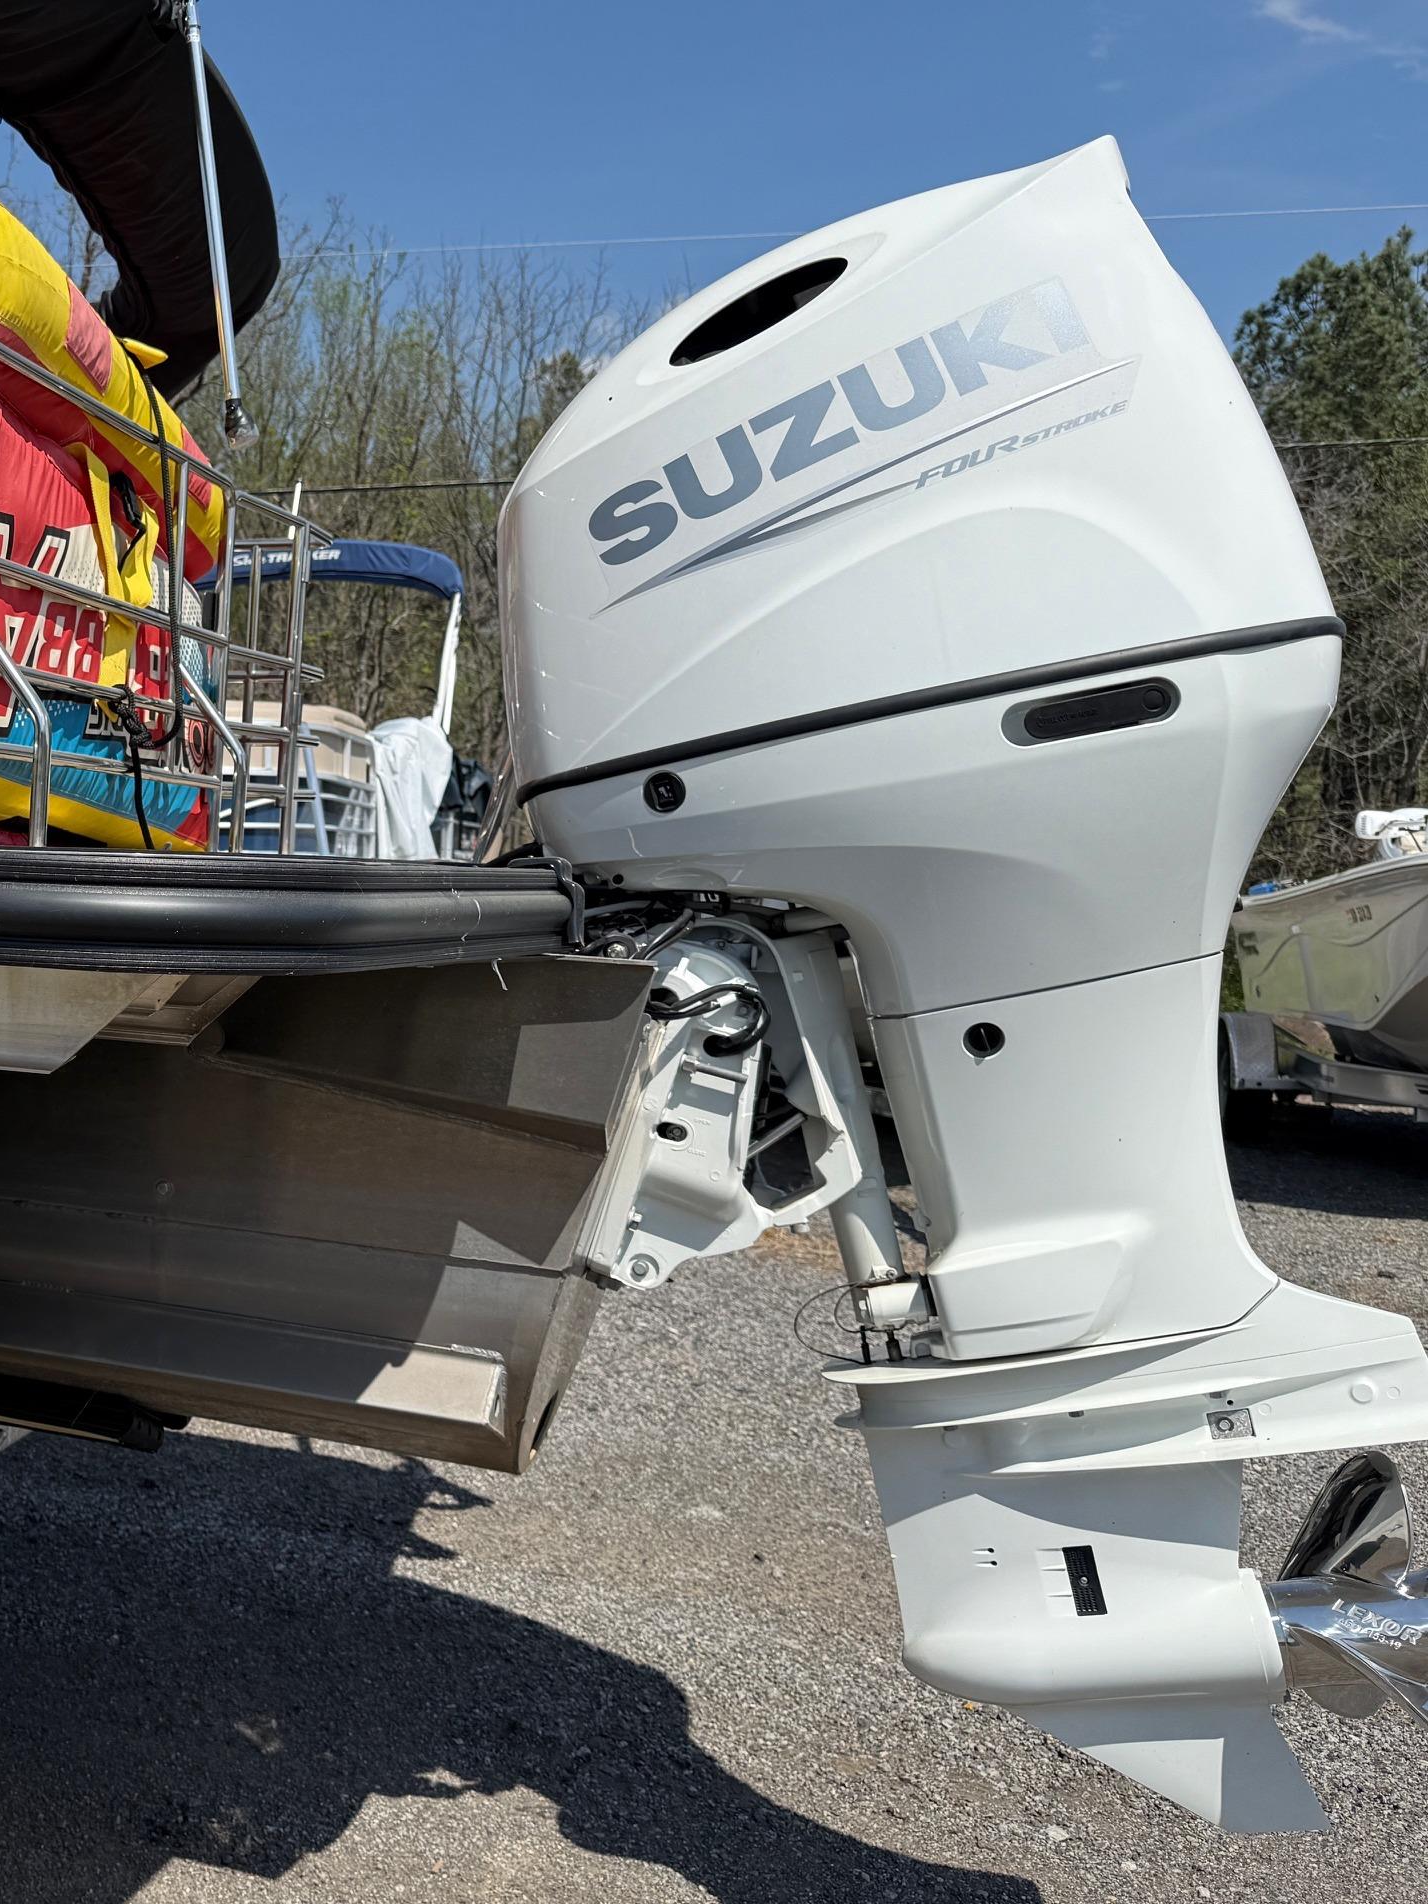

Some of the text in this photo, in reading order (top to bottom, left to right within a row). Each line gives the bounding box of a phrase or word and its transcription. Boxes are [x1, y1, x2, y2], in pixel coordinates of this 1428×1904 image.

[588, 277, 1090, 566] SUZUKI
[915, 400, 1129, 489] FOUR STROKE
[1332, 1598, 1422, 1645] LEXOR
